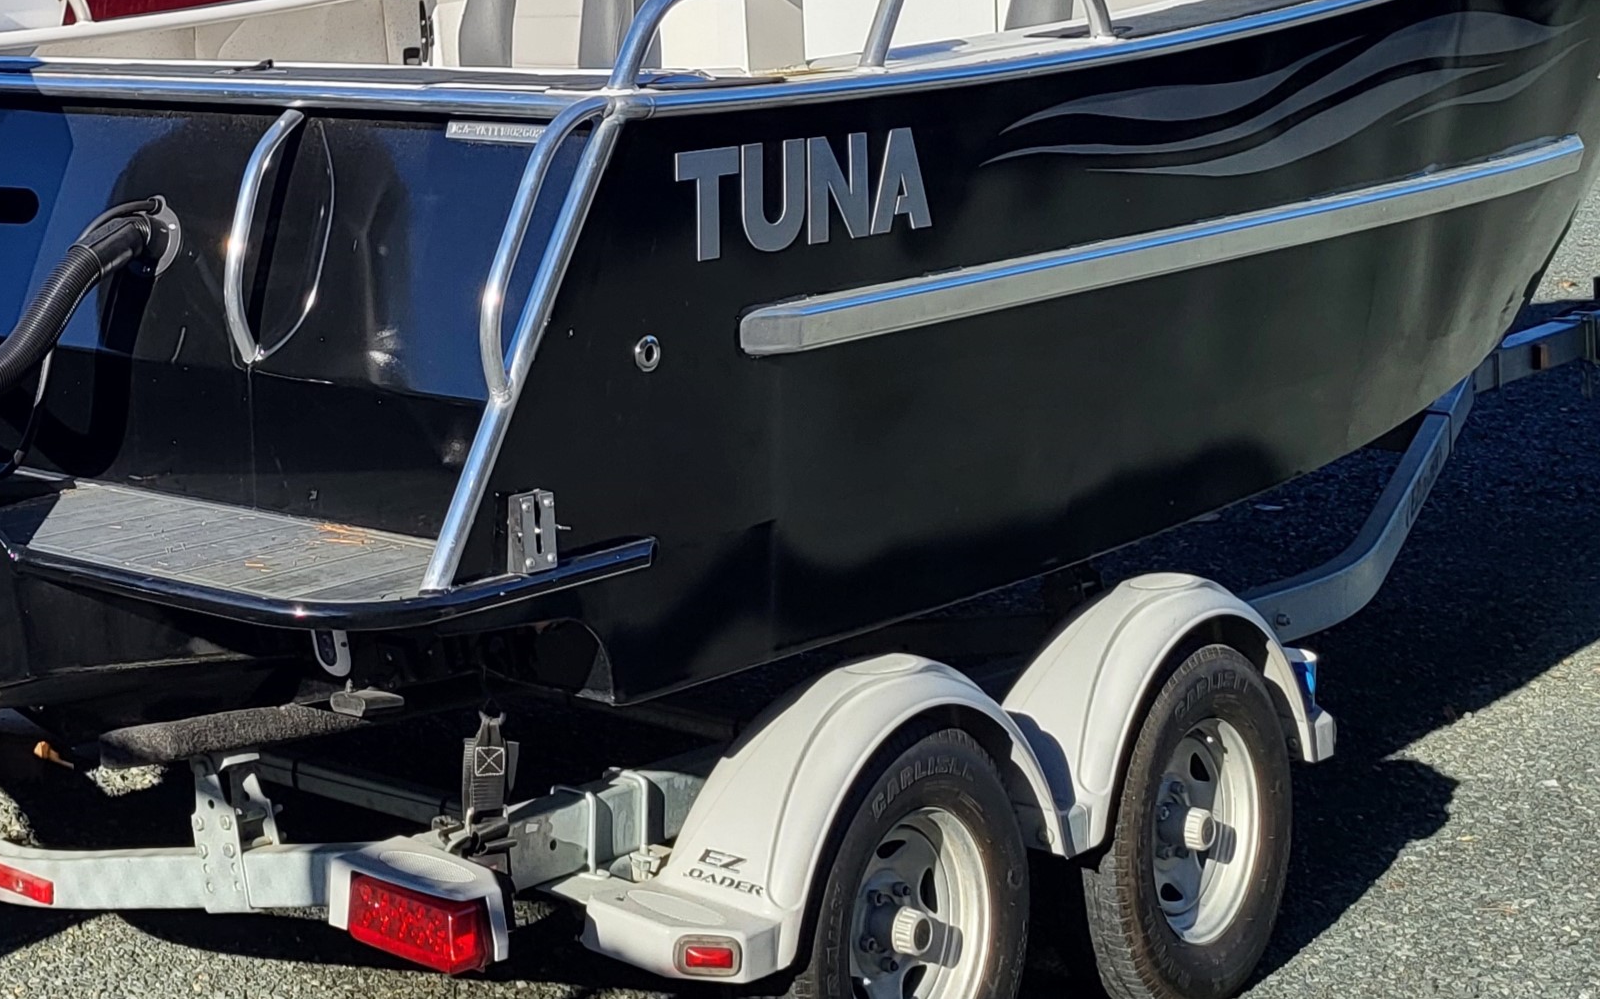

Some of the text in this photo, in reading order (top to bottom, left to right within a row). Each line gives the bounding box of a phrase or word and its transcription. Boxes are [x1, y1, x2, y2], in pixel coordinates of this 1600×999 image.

[674, 126, 932, 262] TUNA
[698, 848, 747, 874] EZ
[682, 867, 764, 898] OADER
